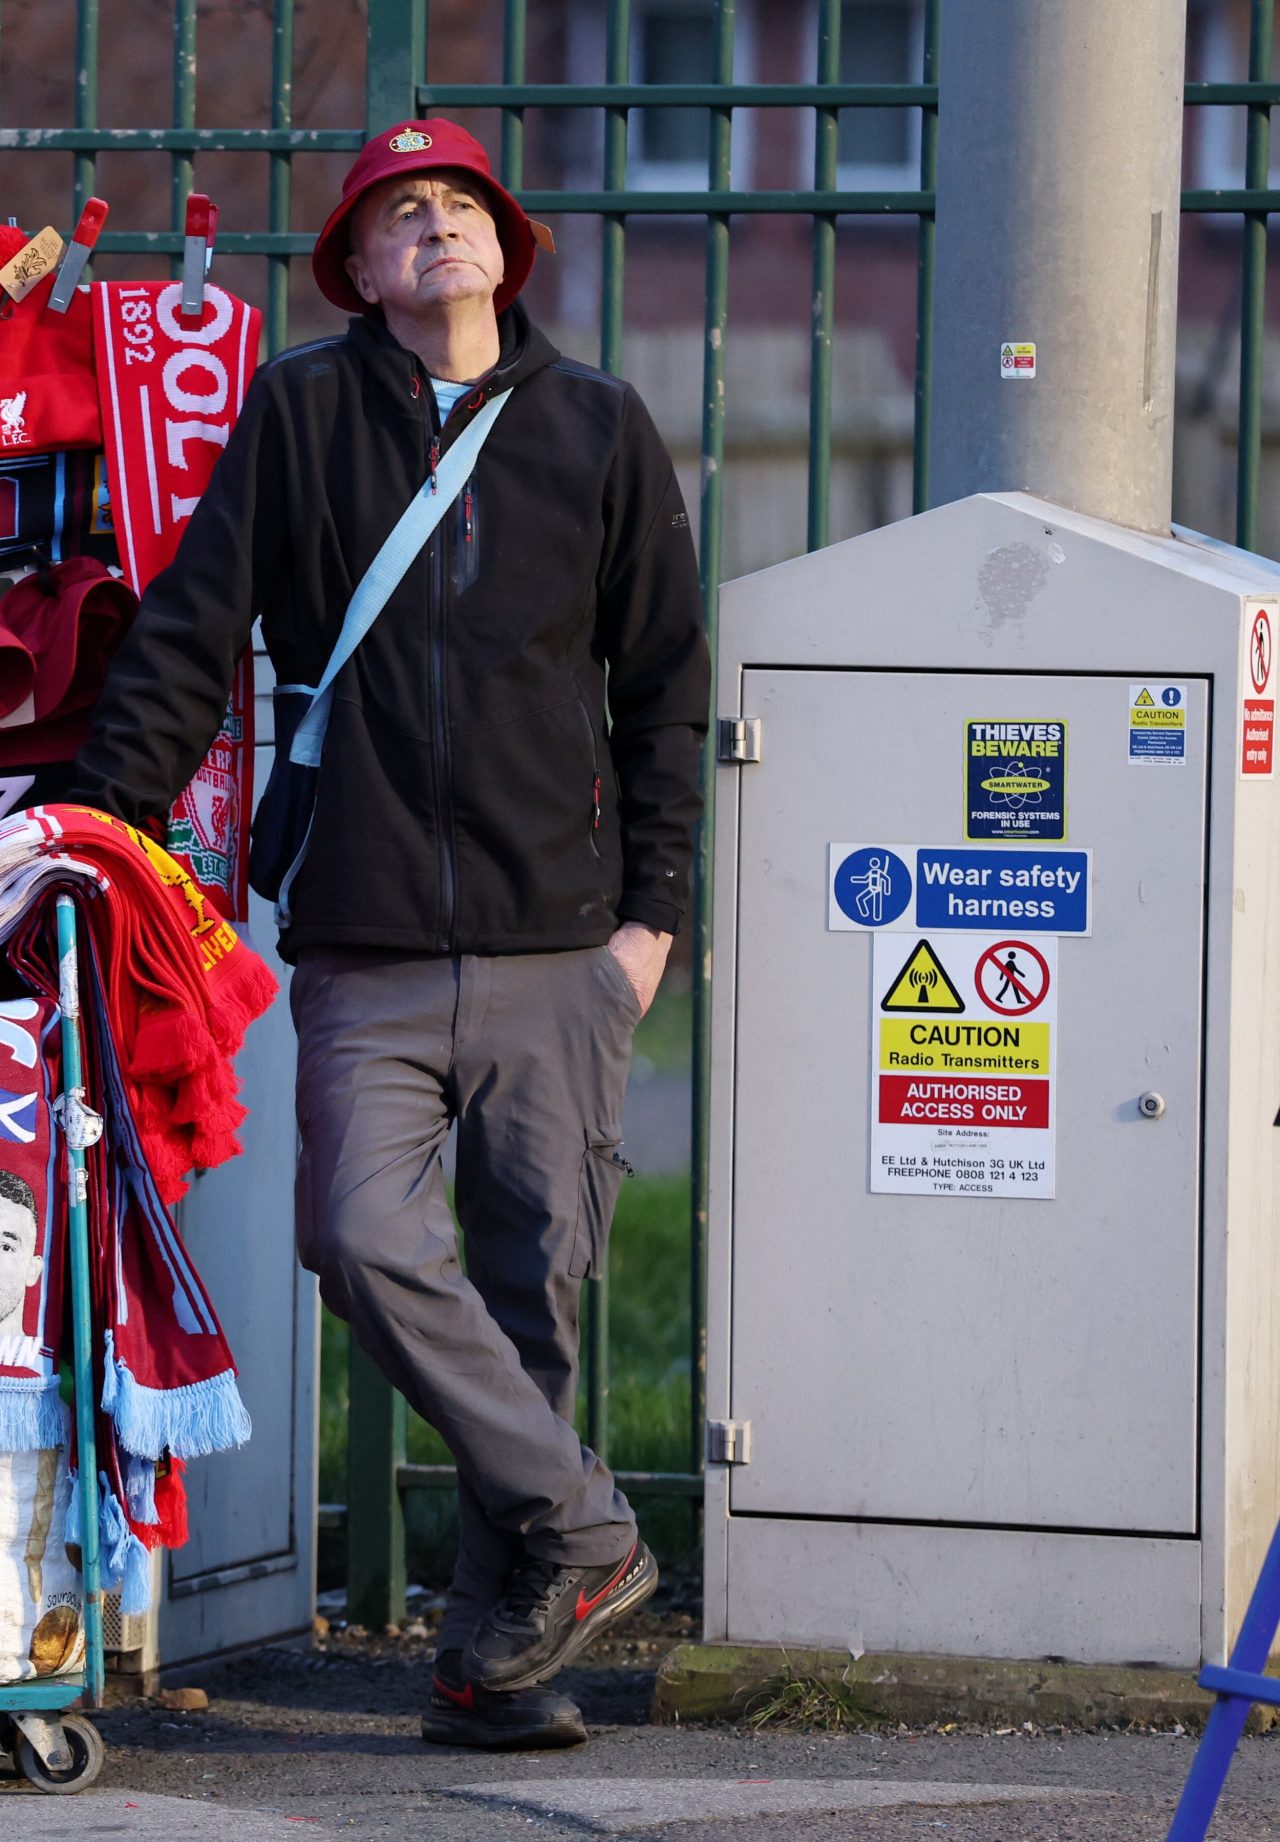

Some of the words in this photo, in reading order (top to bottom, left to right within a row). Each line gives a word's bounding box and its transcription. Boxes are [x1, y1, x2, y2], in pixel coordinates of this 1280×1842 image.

[118, 287, 155, 366] 1892
[1136, 710, 1179, 720] CAUTION
[971, 724, 1061, 741] THIEVES
[971, 740, 1059, 757] BEWARE
[971, 811, 1016, 820] FORENSIC
[1018, 812, 1060, 820] SYSTEMS
[1001, 820, 1011, 828] IN
[1013, 820, 1031, 828] USE
[922, 862, 992, 886] Wear
[999, 864, 1081, 894] safety
[948, 893, 1055, 918] harness
[910, 1024, 1020, 1047] CAUTION
[889, 1051, 934, 1066] Radio
[941, 1053, 1040, 1070] Transmitters
[906, 1083, 1022, 1102] AUTHORISED
[900, 1102, 974, 1120] ACCESS
[981, 1104, 1027, 1121] ONLY
[937, 1128, 953, 1136] Site
[956, 1129, 990, 1138] Address:
[881, 1156, 896, 1166] EE
[899, 1156, 917, 1167] Ltd
[920, 1157, 929, 1167] &
[933, 1157, 985, 1169] Hutchison
[989, 1160, 1005, 1169] 3G
[1009, 1160, 1024, 1170] UK
[1028, 1161, 1046, 1171] Ltd
[887, 1167, 952, 1180] FREEPHONE
[955, 1169, 985, 1180] 0808
[990, 1170, 1005, 1180] 121
[1008, 1171, 1017, 1181] 4
[1021, 1171, 1039, 1182] 123
[933, 1183, 956, 1192] TYPE:
[959, 1183, 993, 1193] ACCESS
